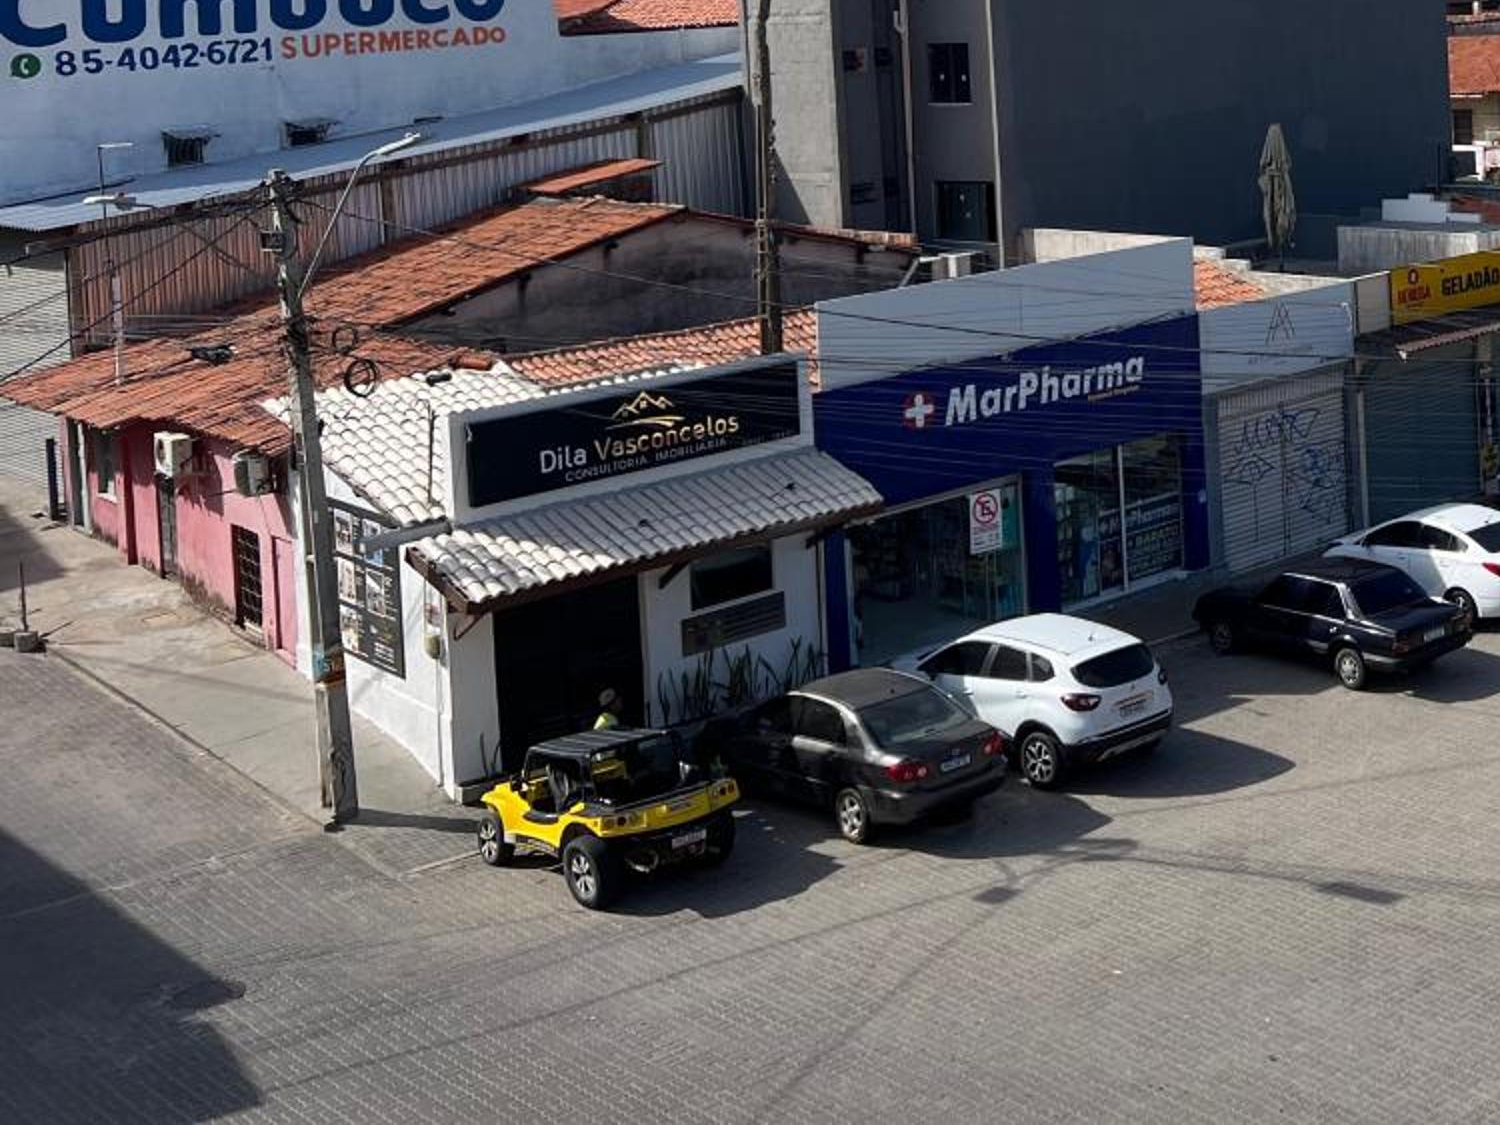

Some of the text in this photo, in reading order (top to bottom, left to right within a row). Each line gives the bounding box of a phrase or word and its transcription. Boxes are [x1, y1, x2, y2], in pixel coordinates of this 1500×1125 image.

[55, 36, 273, 76] 85-4042-6721
[281, 26, 507, 59] SUPERMERCADO
[1441, 266, 1500, 296] GELADÃO
[945, 357, 1144, 426] MarPharma
[539, 444, 588, 473] Dila
[594, 415, 740, 461] Vasconcelos
[565, 455, 650, 482] CONSULTORIA
